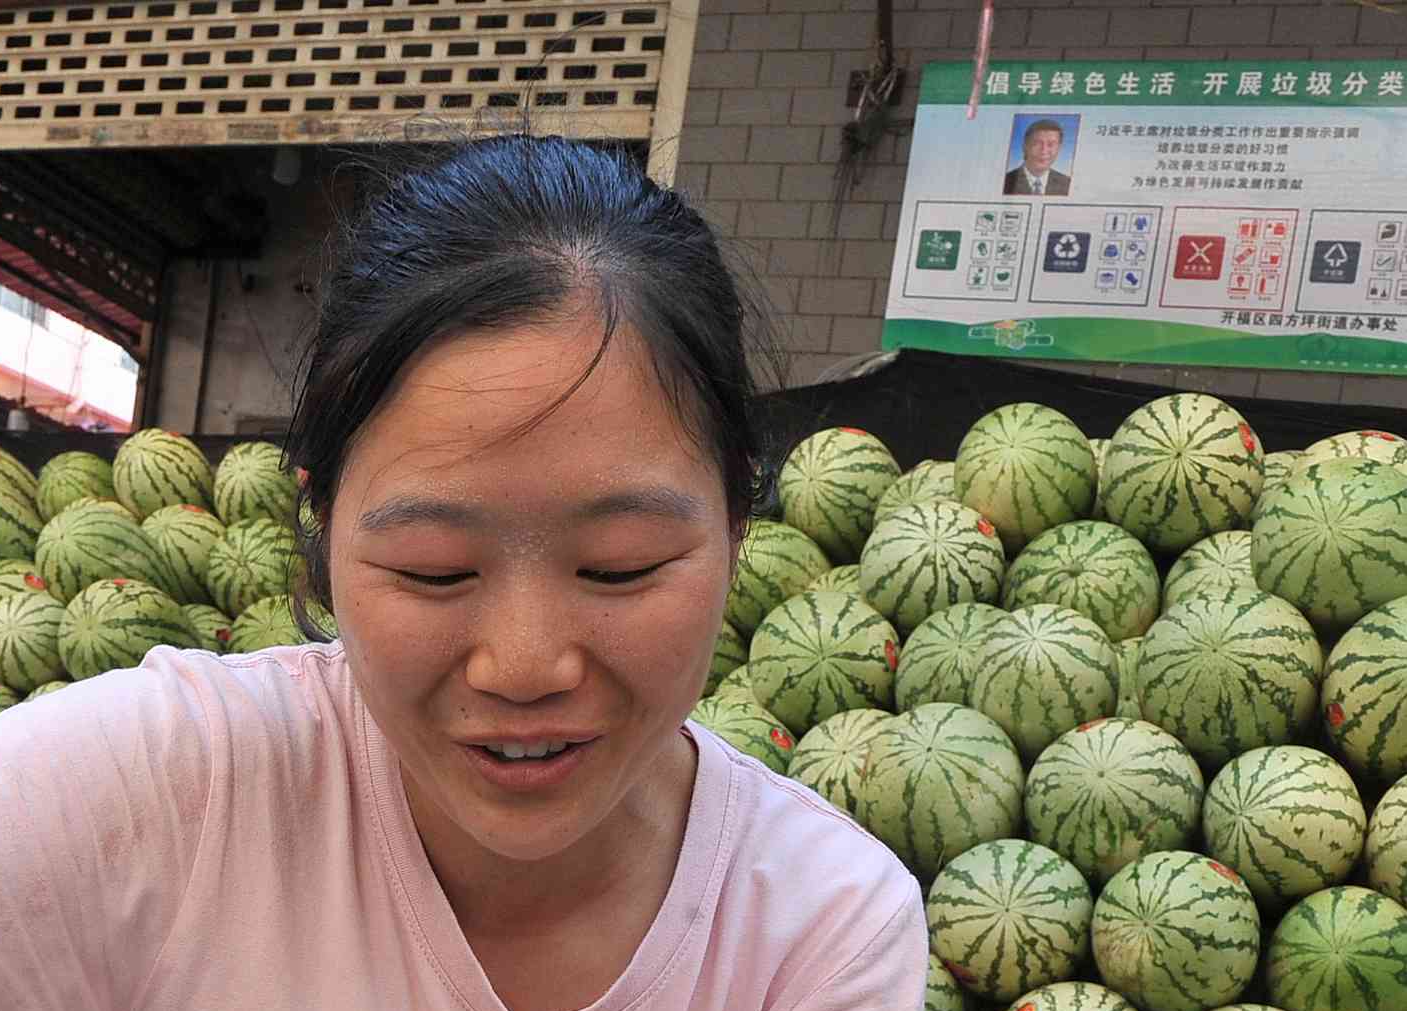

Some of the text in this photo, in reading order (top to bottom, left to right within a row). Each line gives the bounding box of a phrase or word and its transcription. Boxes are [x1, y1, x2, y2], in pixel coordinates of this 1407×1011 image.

[985, 71, 1405, 97] 倡导绿色生活 开展垃圾分类
[1220, 311, 1398, 332] 开福区四方坪街道办事处
